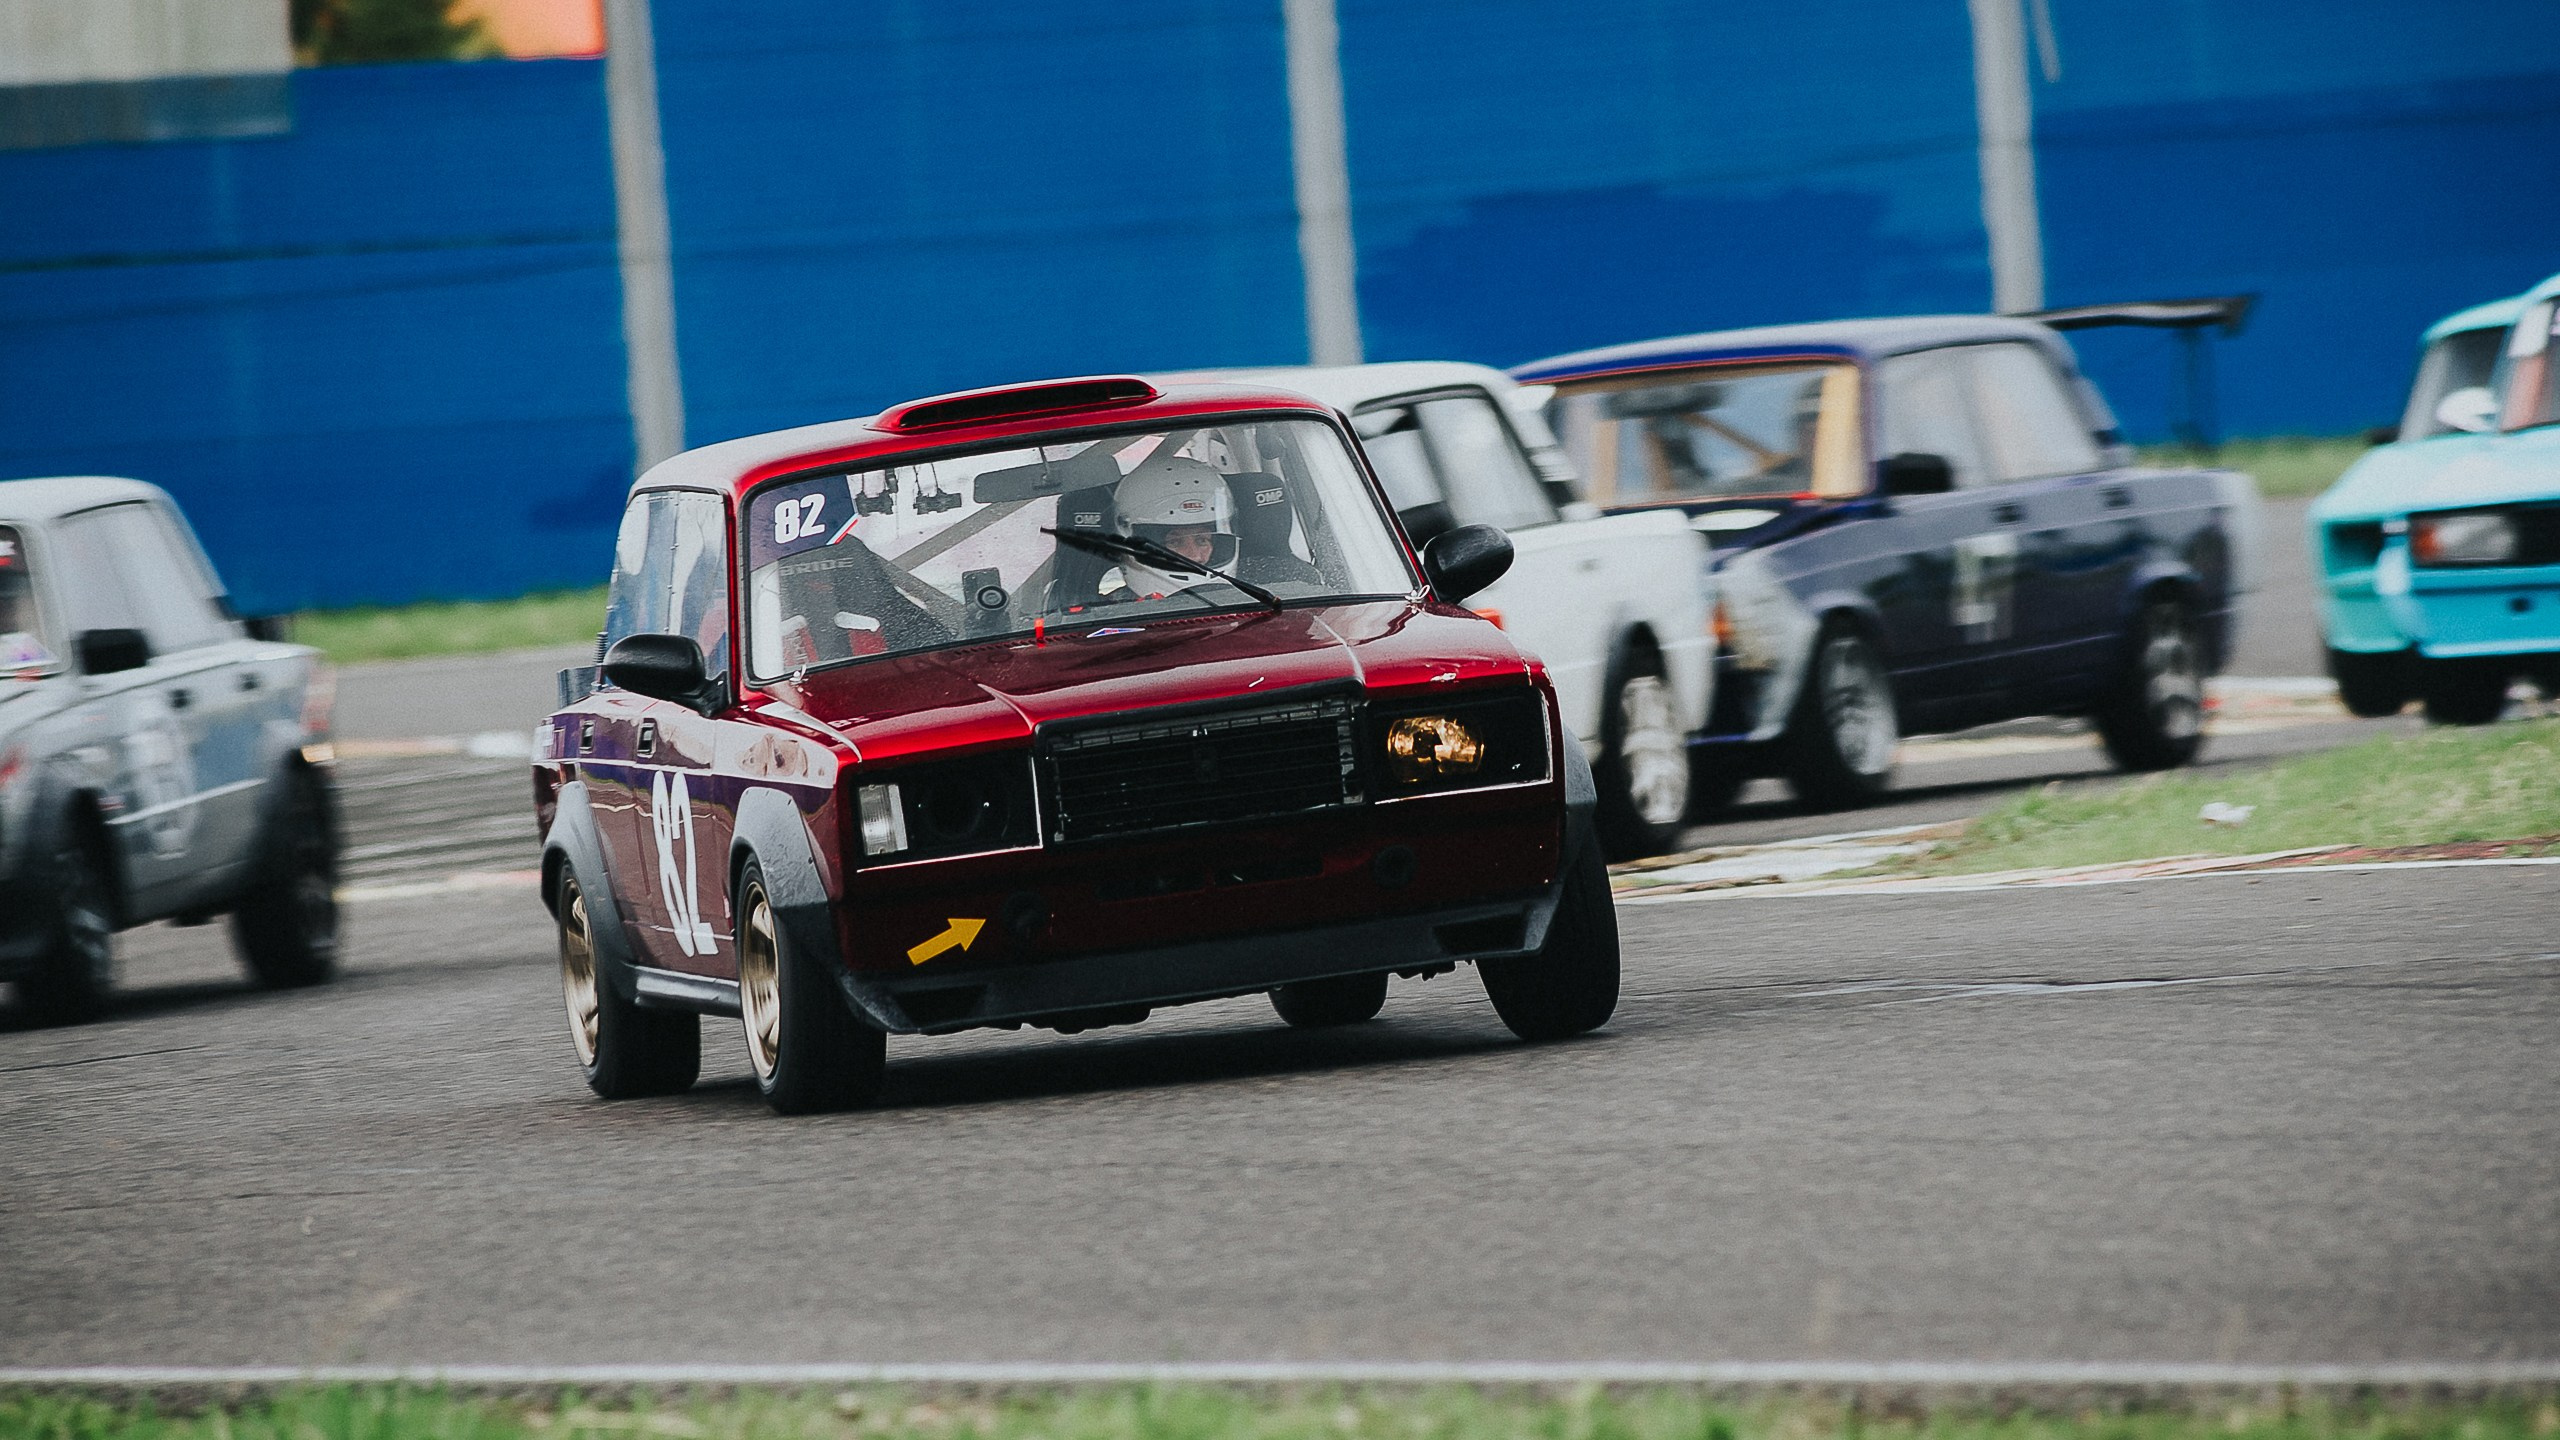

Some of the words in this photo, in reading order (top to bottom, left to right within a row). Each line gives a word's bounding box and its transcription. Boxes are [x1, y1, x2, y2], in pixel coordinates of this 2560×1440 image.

[774, 493, 826, 544] 82
[779, 557, 854, 577] BRIDE
[652, 770, 719, 958] 82
